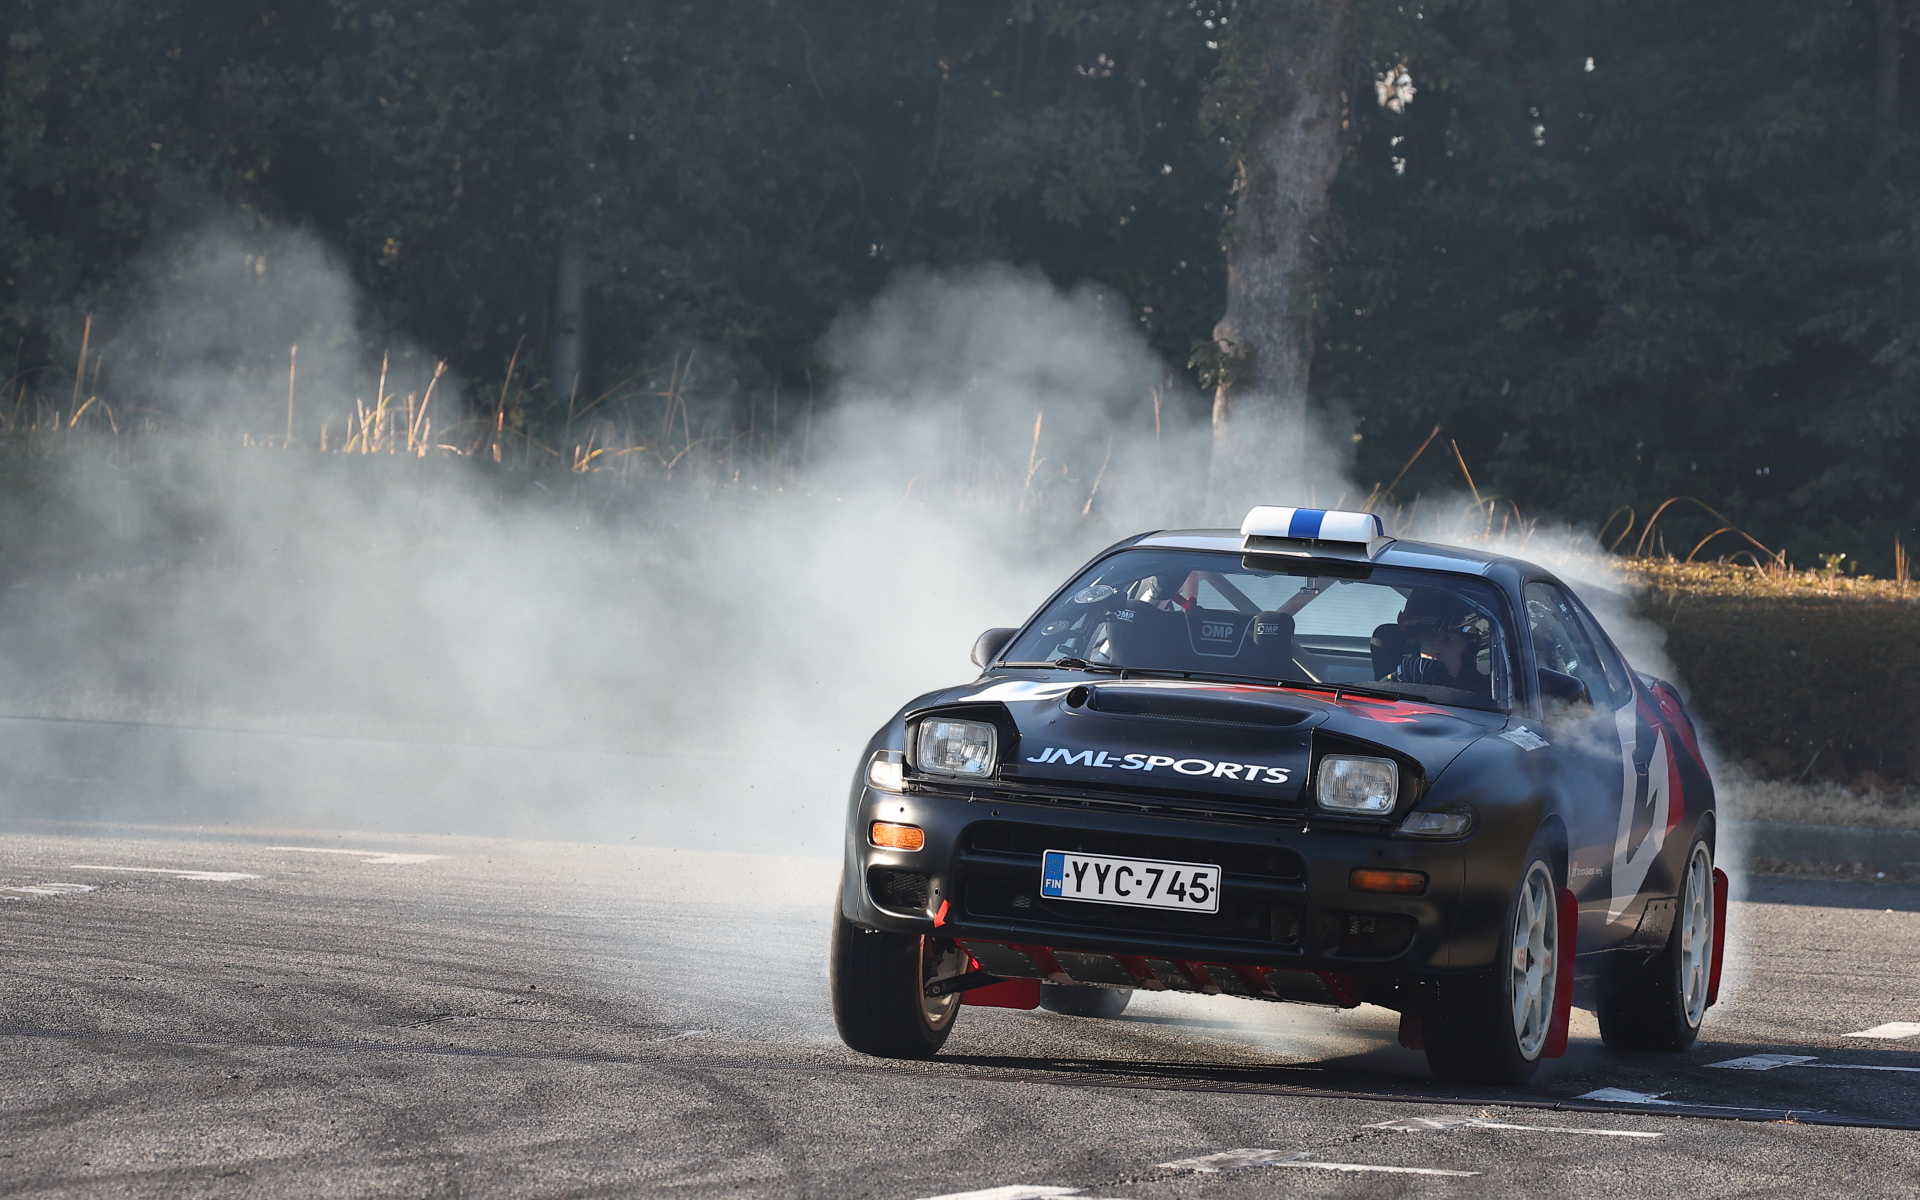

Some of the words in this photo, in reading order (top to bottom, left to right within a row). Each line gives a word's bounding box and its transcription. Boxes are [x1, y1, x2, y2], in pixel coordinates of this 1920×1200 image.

[1201, 624, 1234, 639] OMP
[1257, 625, 1278, 634] OMP
[1026, 747, 1292, 784] JML-SPORTS
[1045, 878, 1062, 889] FIN
